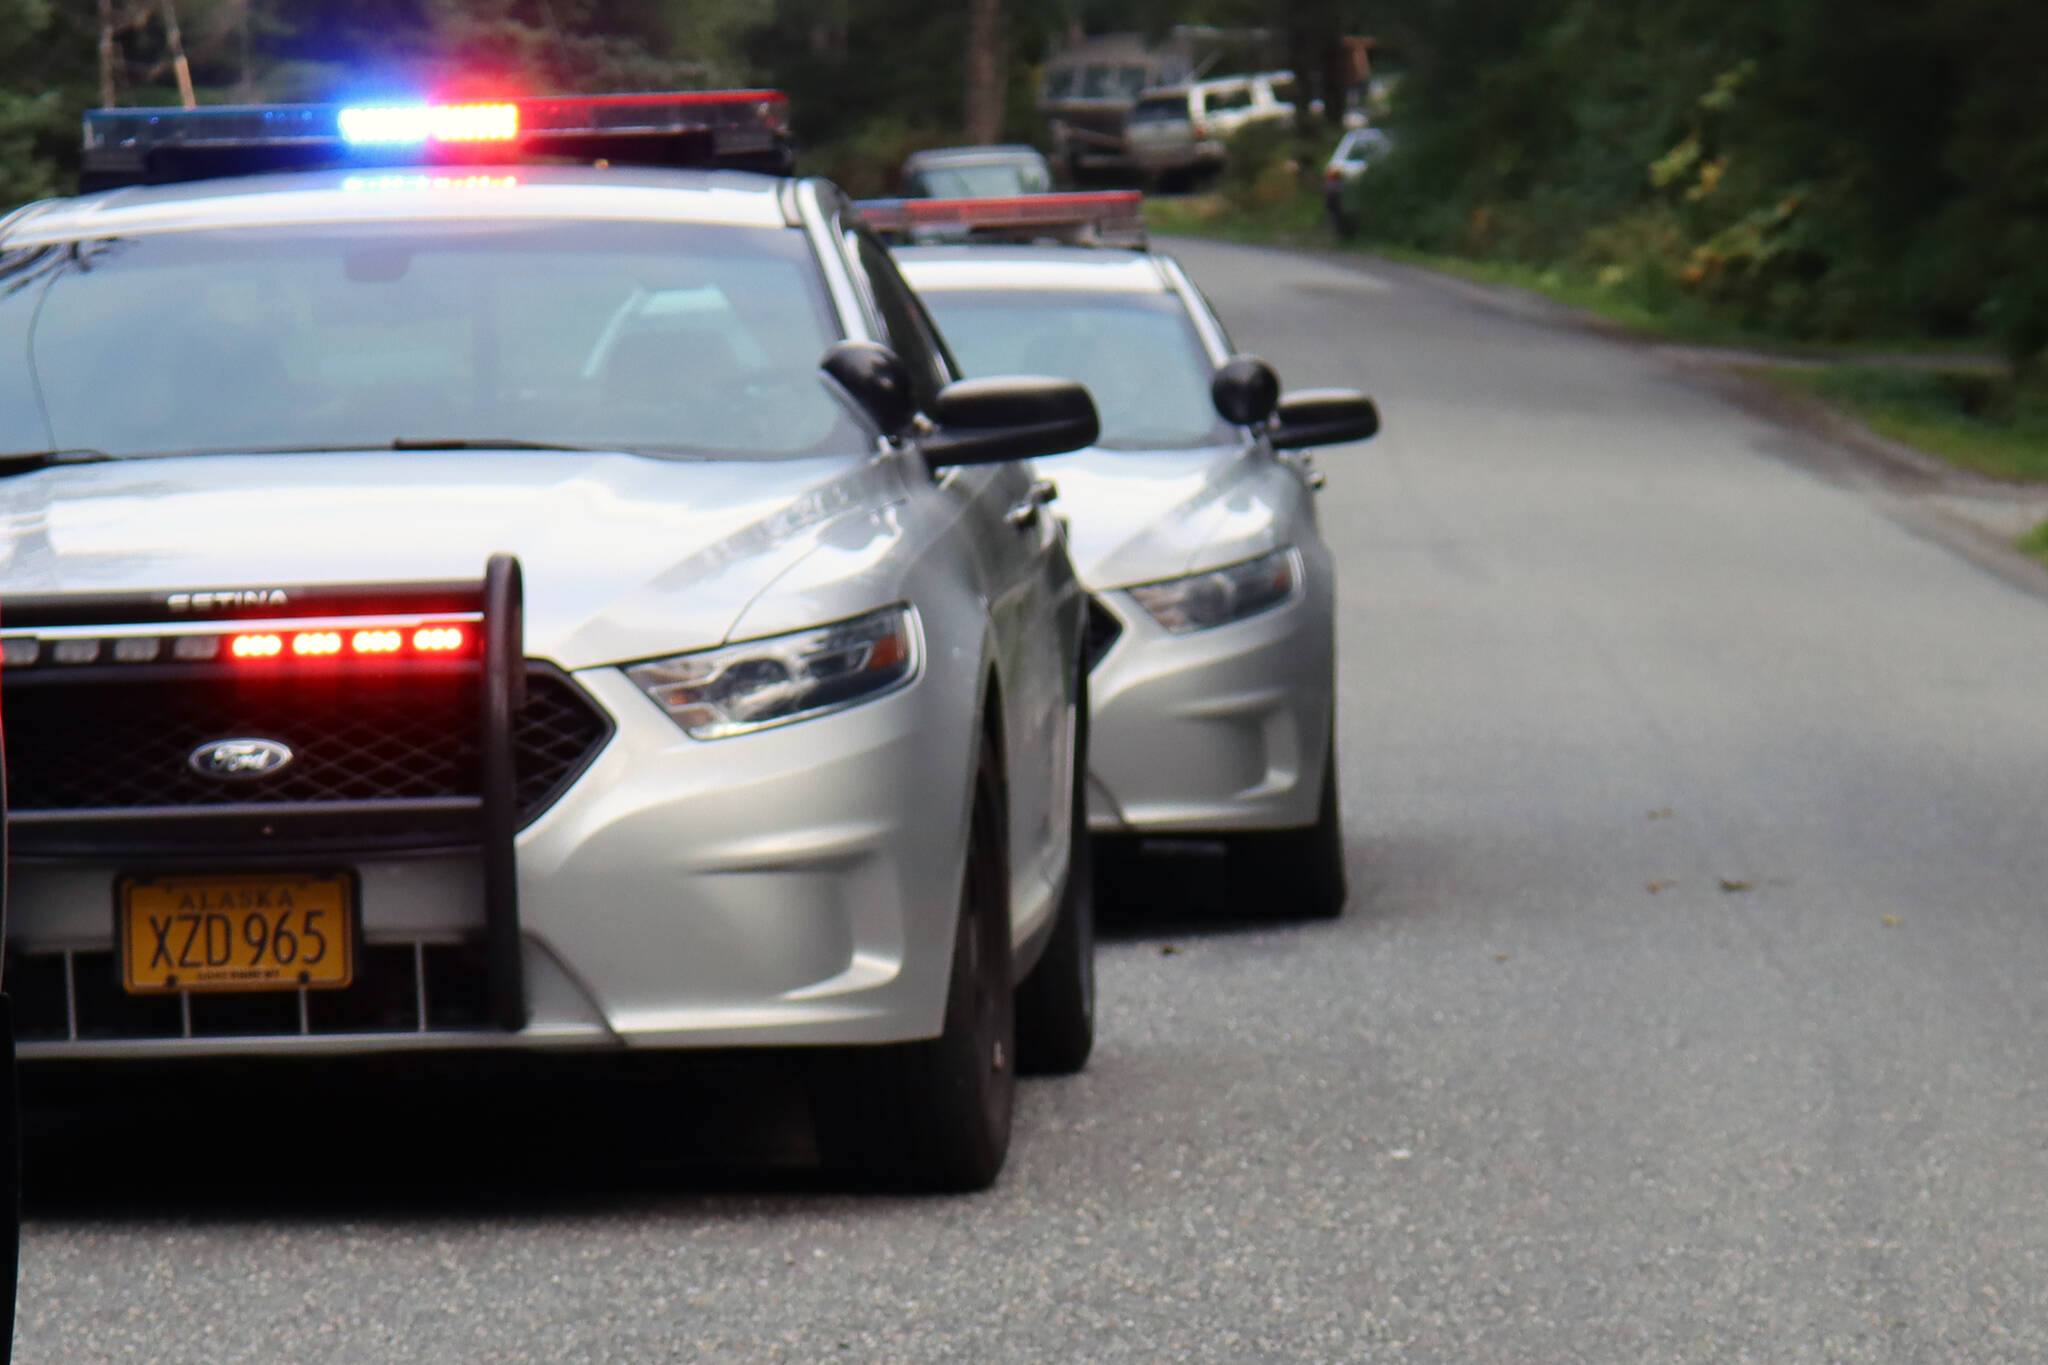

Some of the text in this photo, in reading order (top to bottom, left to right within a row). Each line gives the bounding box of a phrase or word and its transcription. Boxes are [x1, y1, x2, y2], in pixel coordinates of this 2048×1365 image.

[211, 744, 271, 772] Ford
[178, 888, 295, 911] ALASKA
[150, 910, 326, 969] XZD 965
